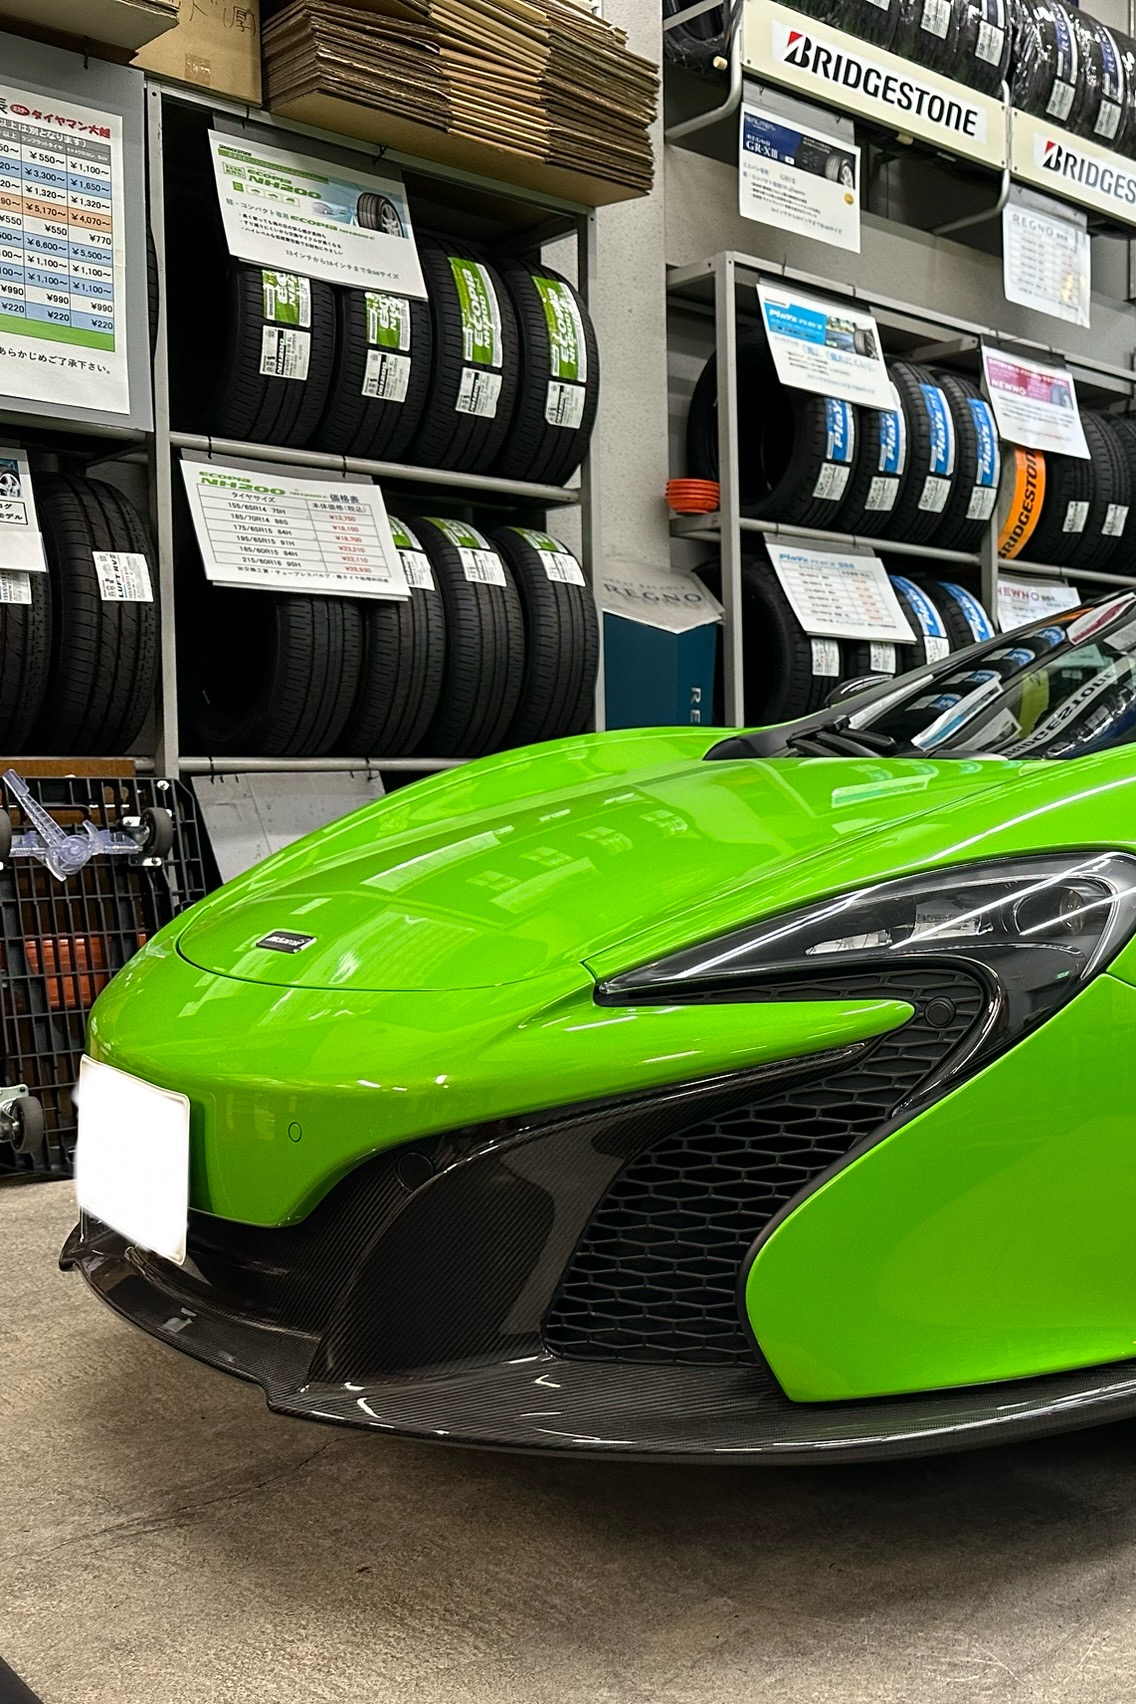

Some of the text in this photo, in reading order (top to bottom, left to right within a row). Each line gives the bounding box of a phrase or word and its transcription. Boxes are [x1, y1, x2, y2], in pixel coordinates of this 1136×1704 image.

[784, 30, 978, 136] BRIDGESTONE
[248, 174, 322, 199] NH200
[201, 477, 286, 496] NH200
[602, 582, 702, 604] REGNO
